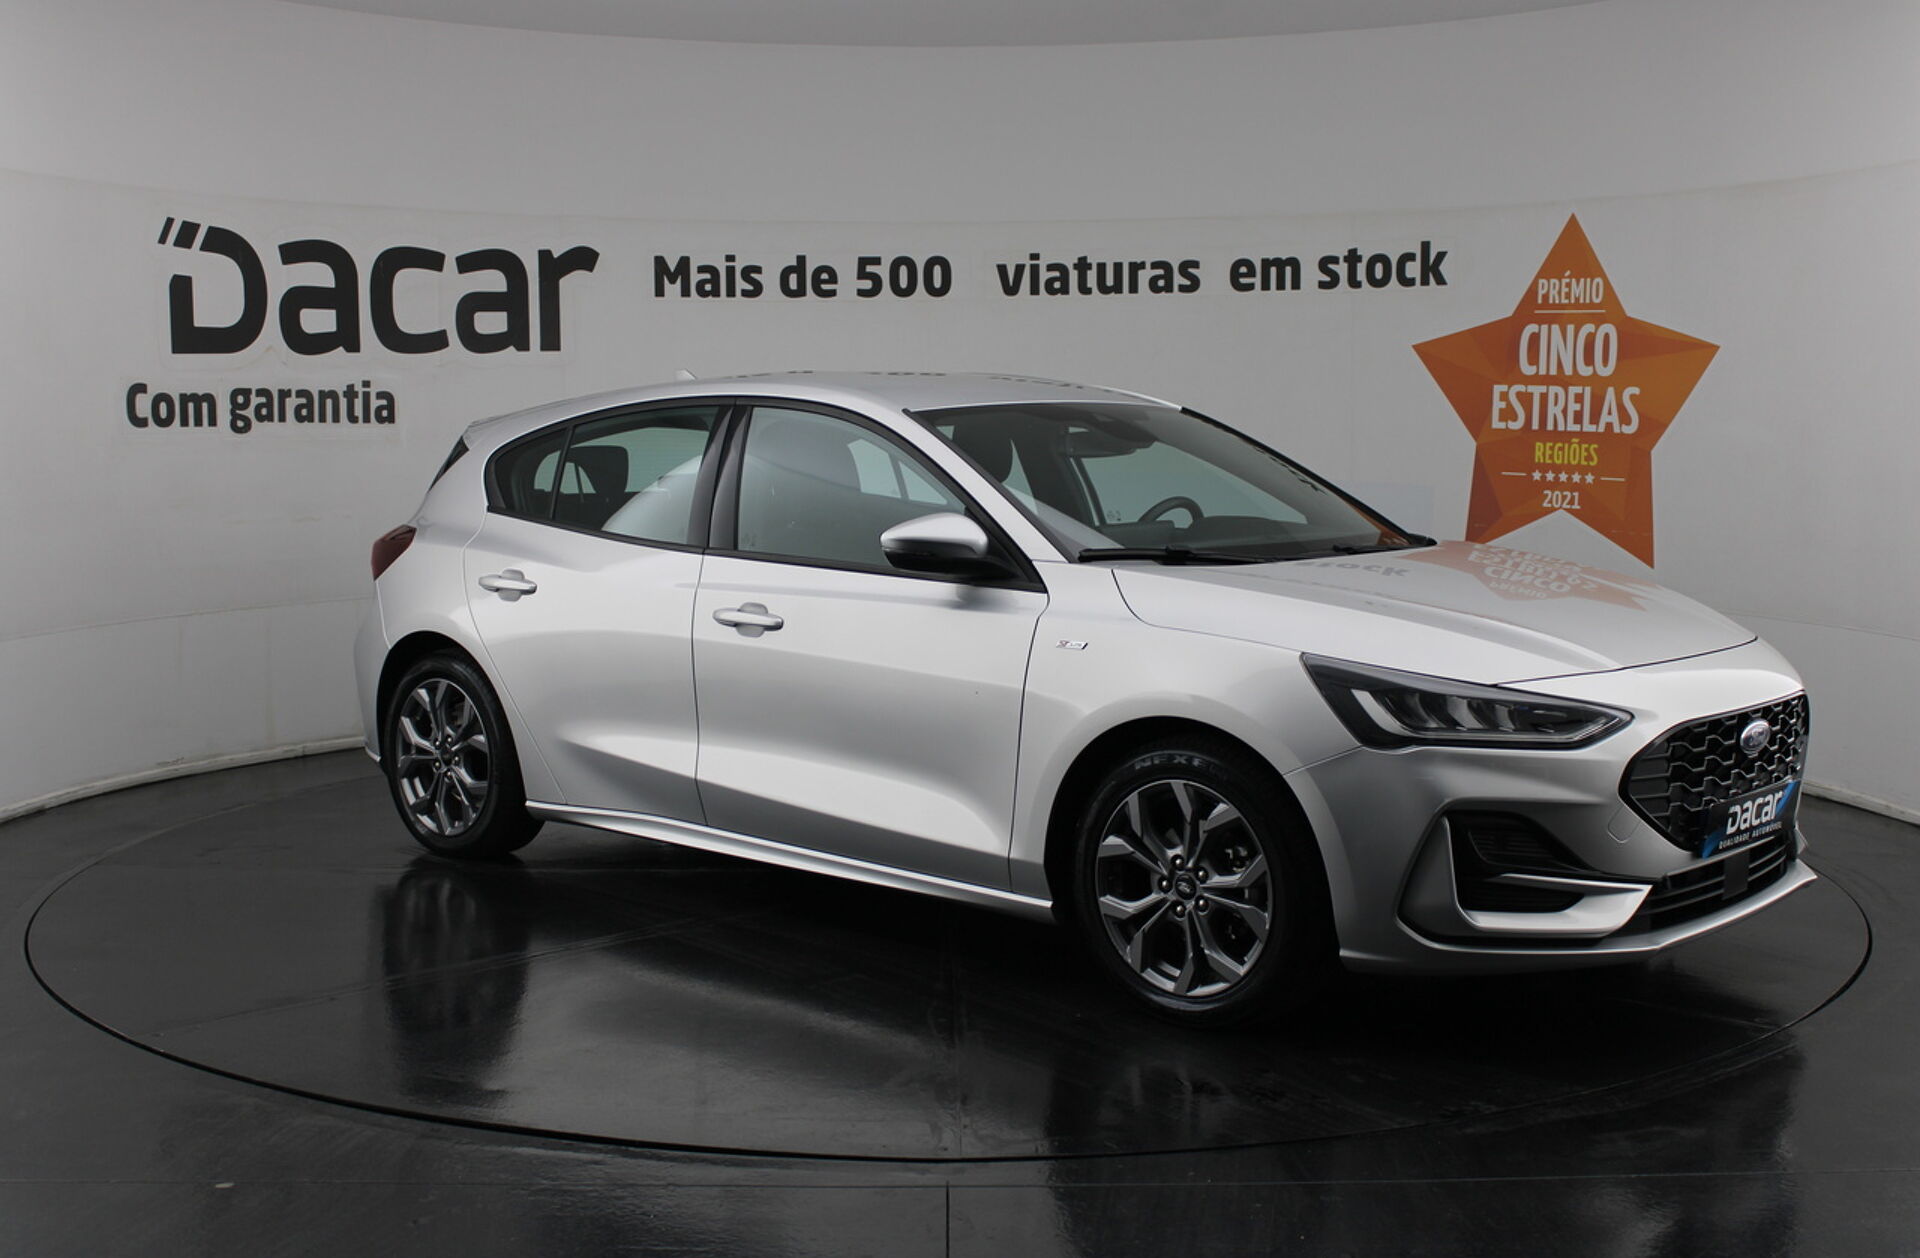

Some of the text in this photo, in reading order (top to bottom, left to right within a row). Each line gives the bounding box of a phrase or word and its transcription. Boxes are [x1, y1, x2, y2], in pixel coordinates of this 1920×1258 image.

[158, 217, 600, 355] Dacar
[653, 241, 1449, 299] Mais de 500 viaturas em stock
[1537, 270, 1604, 305] PRÉMIO
[1519, 323, 1618, 377] CINCO
[126, 380, 396, 435] Com garantia
[1491, 384, 1641, 435] ESTRELAS
[1535, 438, 1598, 466] REGIÕES
[1542, 489, 1581, 510] 2021
[1726, 791, 1784, 834] Dacar
